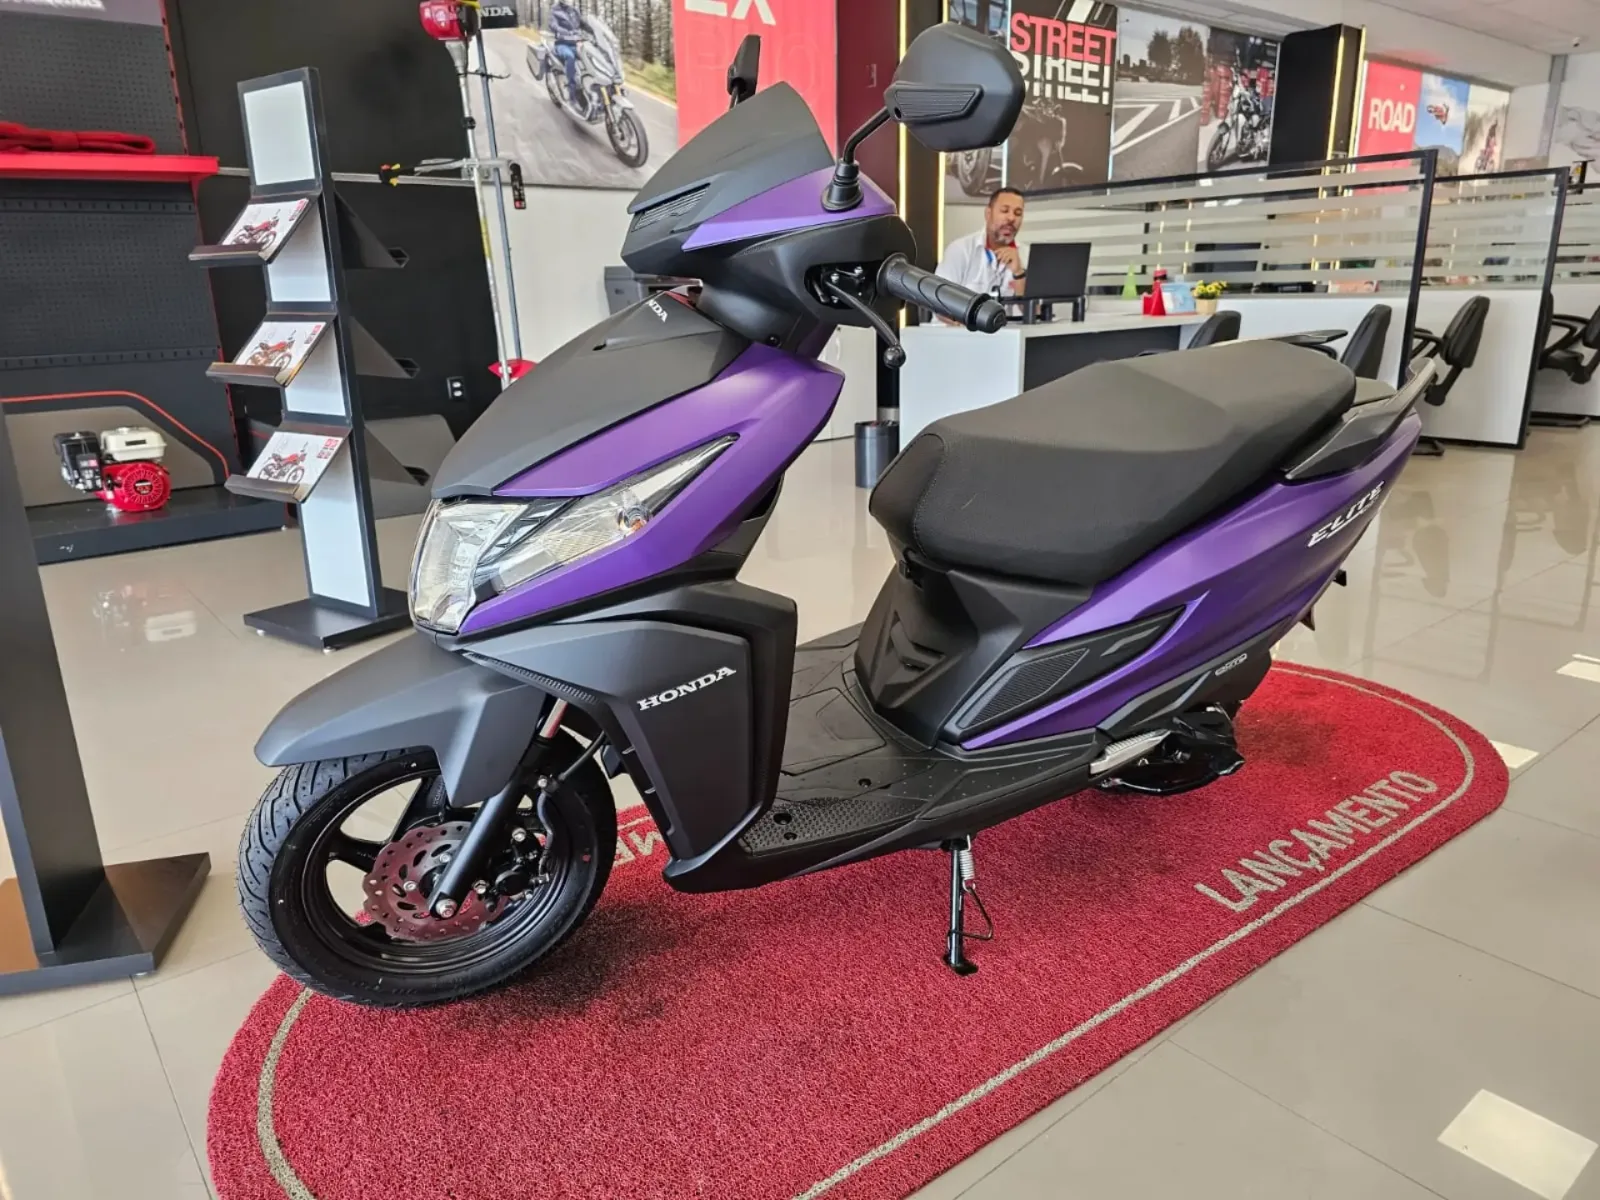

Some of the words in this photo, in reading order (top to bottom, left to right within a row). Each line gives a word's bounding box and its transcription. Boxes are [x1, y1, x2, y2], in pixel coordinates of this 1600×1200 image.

[480, 6, 514, 17] NDA
[1010, 12, 1117, 66] STREET
[1368, 97, 1416, 134] ROAD
[649, 299, 668, 323] NDA
[1307, 480, 1385, 547] ELITE
[636, 666, 737, 711] HONDA
[1194, 771, 1438, 913] LANÇAMENTO
